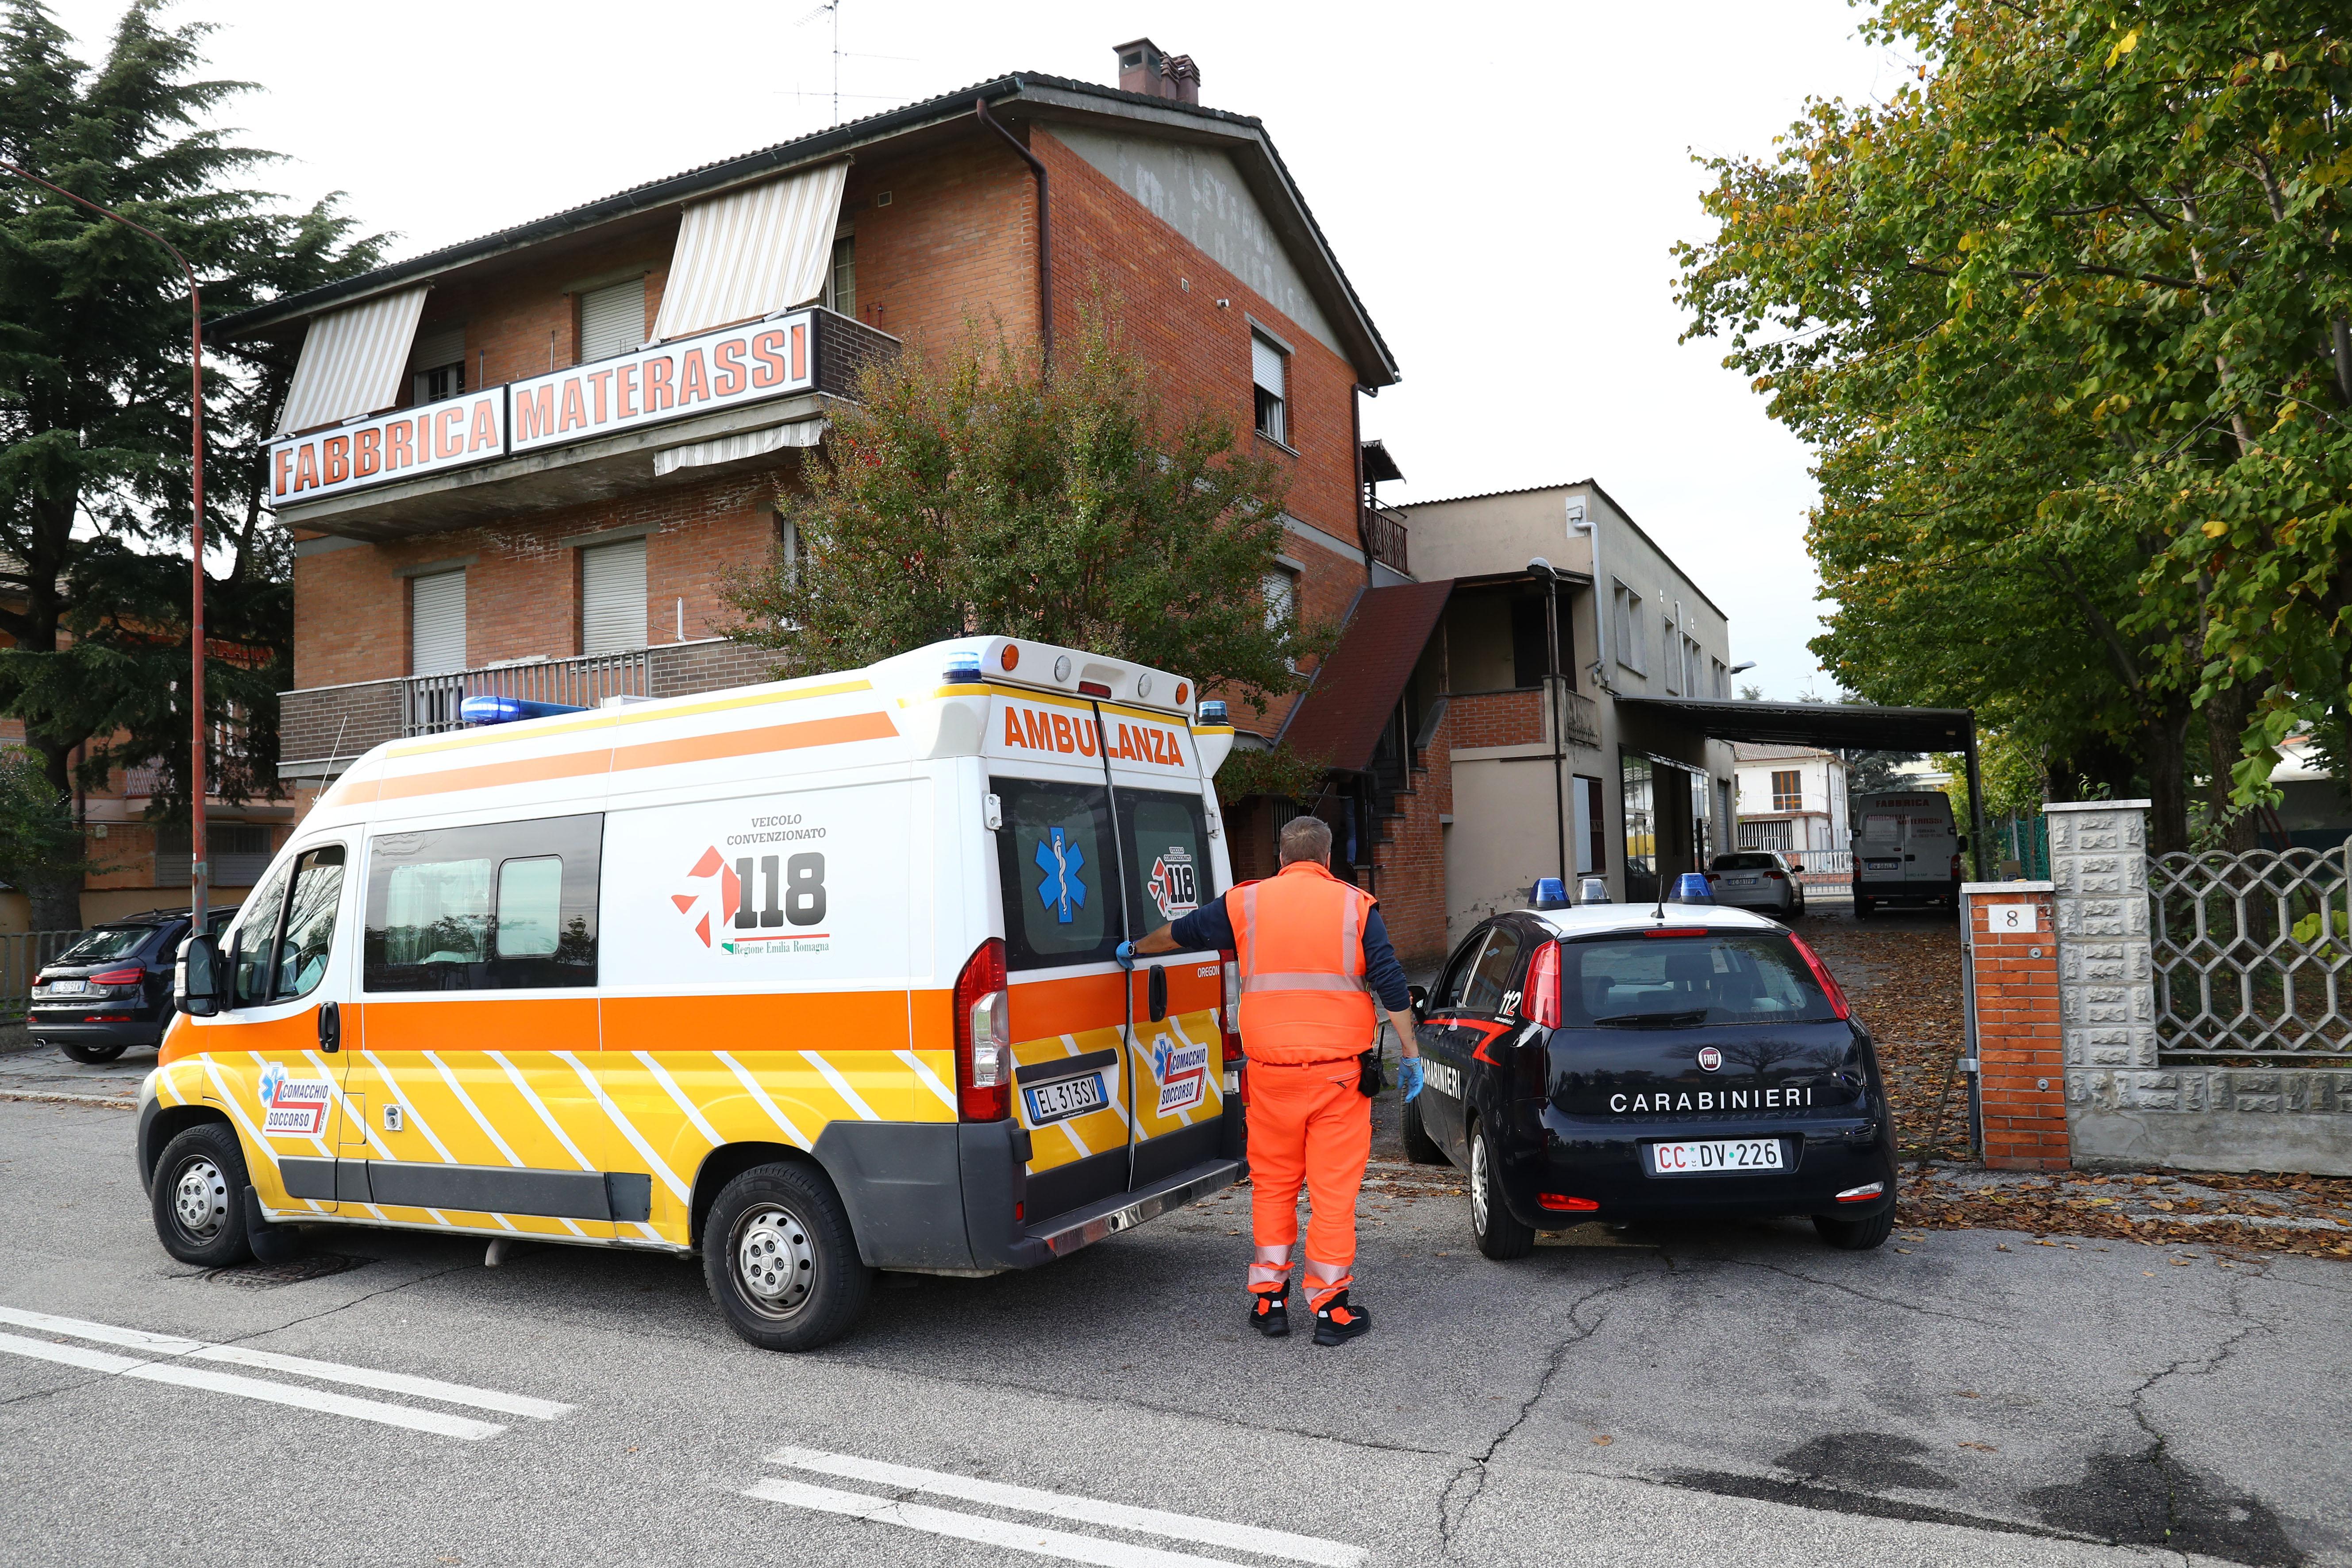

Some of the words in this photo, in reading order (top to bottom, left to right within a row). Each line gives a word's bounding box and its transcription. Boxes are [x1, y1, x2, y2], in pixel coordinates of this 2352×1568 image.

[274, 398, 498, 497] FABBRICA
[515, 324, 807, 443] MATERASSI
[1005, 706, 1185, 767] AMBULANZA
[1876, 799, 1929, 808] FABBRICA
[751, 814, 802, 828] VEICOLO
[727, 828, 826, 845] CONVENZIONATO
[735, 852, 827, 929] 118
[1168, 867, 1195, 903] 118
[2007, 910, 2018, 927] 8
[735, 943, 764, 957] Regione
[766, 941, 790, 953] Emilia
[793, 940, 829, 955] Romagna
[1197, 965, 1220, 978] OREGON
[55, 982, 61, 991] EL
[1499, 990, 1522, 1017] 112
[1172, 1048, 1205, 1071] COMACCHIO
[1704, 1054, 1717, 1065] FIAT
[282, 1084, 328, 1098] COMACCHIO
[1037, 1089, 1057, 1114] EL
[1057, 1079, 1097, 1109] 313SV
[1162, 1082, 1193, 1105] SOCCORSO
[1610, 1088, 1811, 1113] CARABINIERI
[269, 1112, 309, 1127] SOCCORSO
[1659, 1146, 1686, 1169] CC
[1700, 1144, 1725, 1167] DV
[1736, 1143, 1777, 1166] 226
